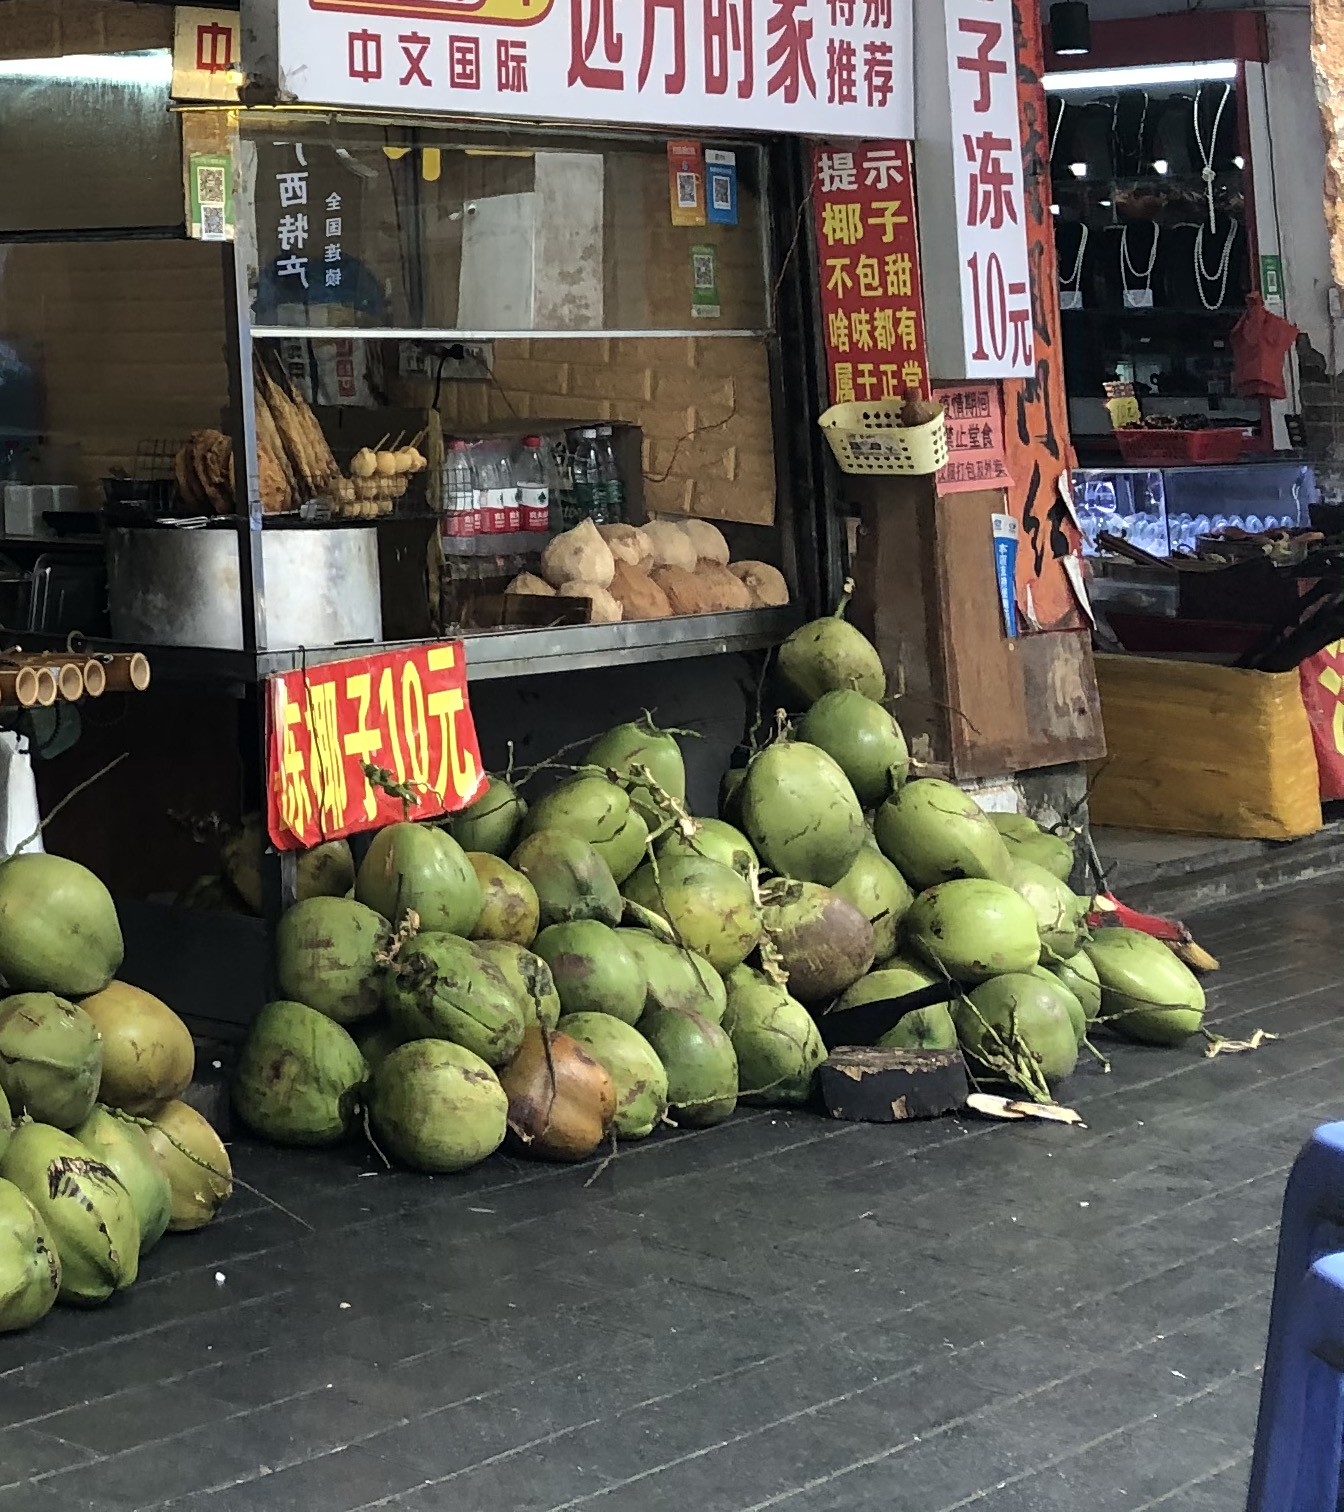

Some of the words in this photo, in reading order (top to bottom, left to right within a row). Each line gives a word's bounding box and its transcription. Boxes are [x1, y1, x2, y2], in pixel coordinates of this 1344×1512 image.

[196, 21, 233, 75] 中
[348, 28, 528, 92] 中文国际
[825, 36, 894, 108] 推荐
[817, 149, 904, 193] 提示
[822, 200, 910, 246] 椰子
[826, 252, 912, 299] 不包甜
[828, 307, 918, 354] 啥味都有
